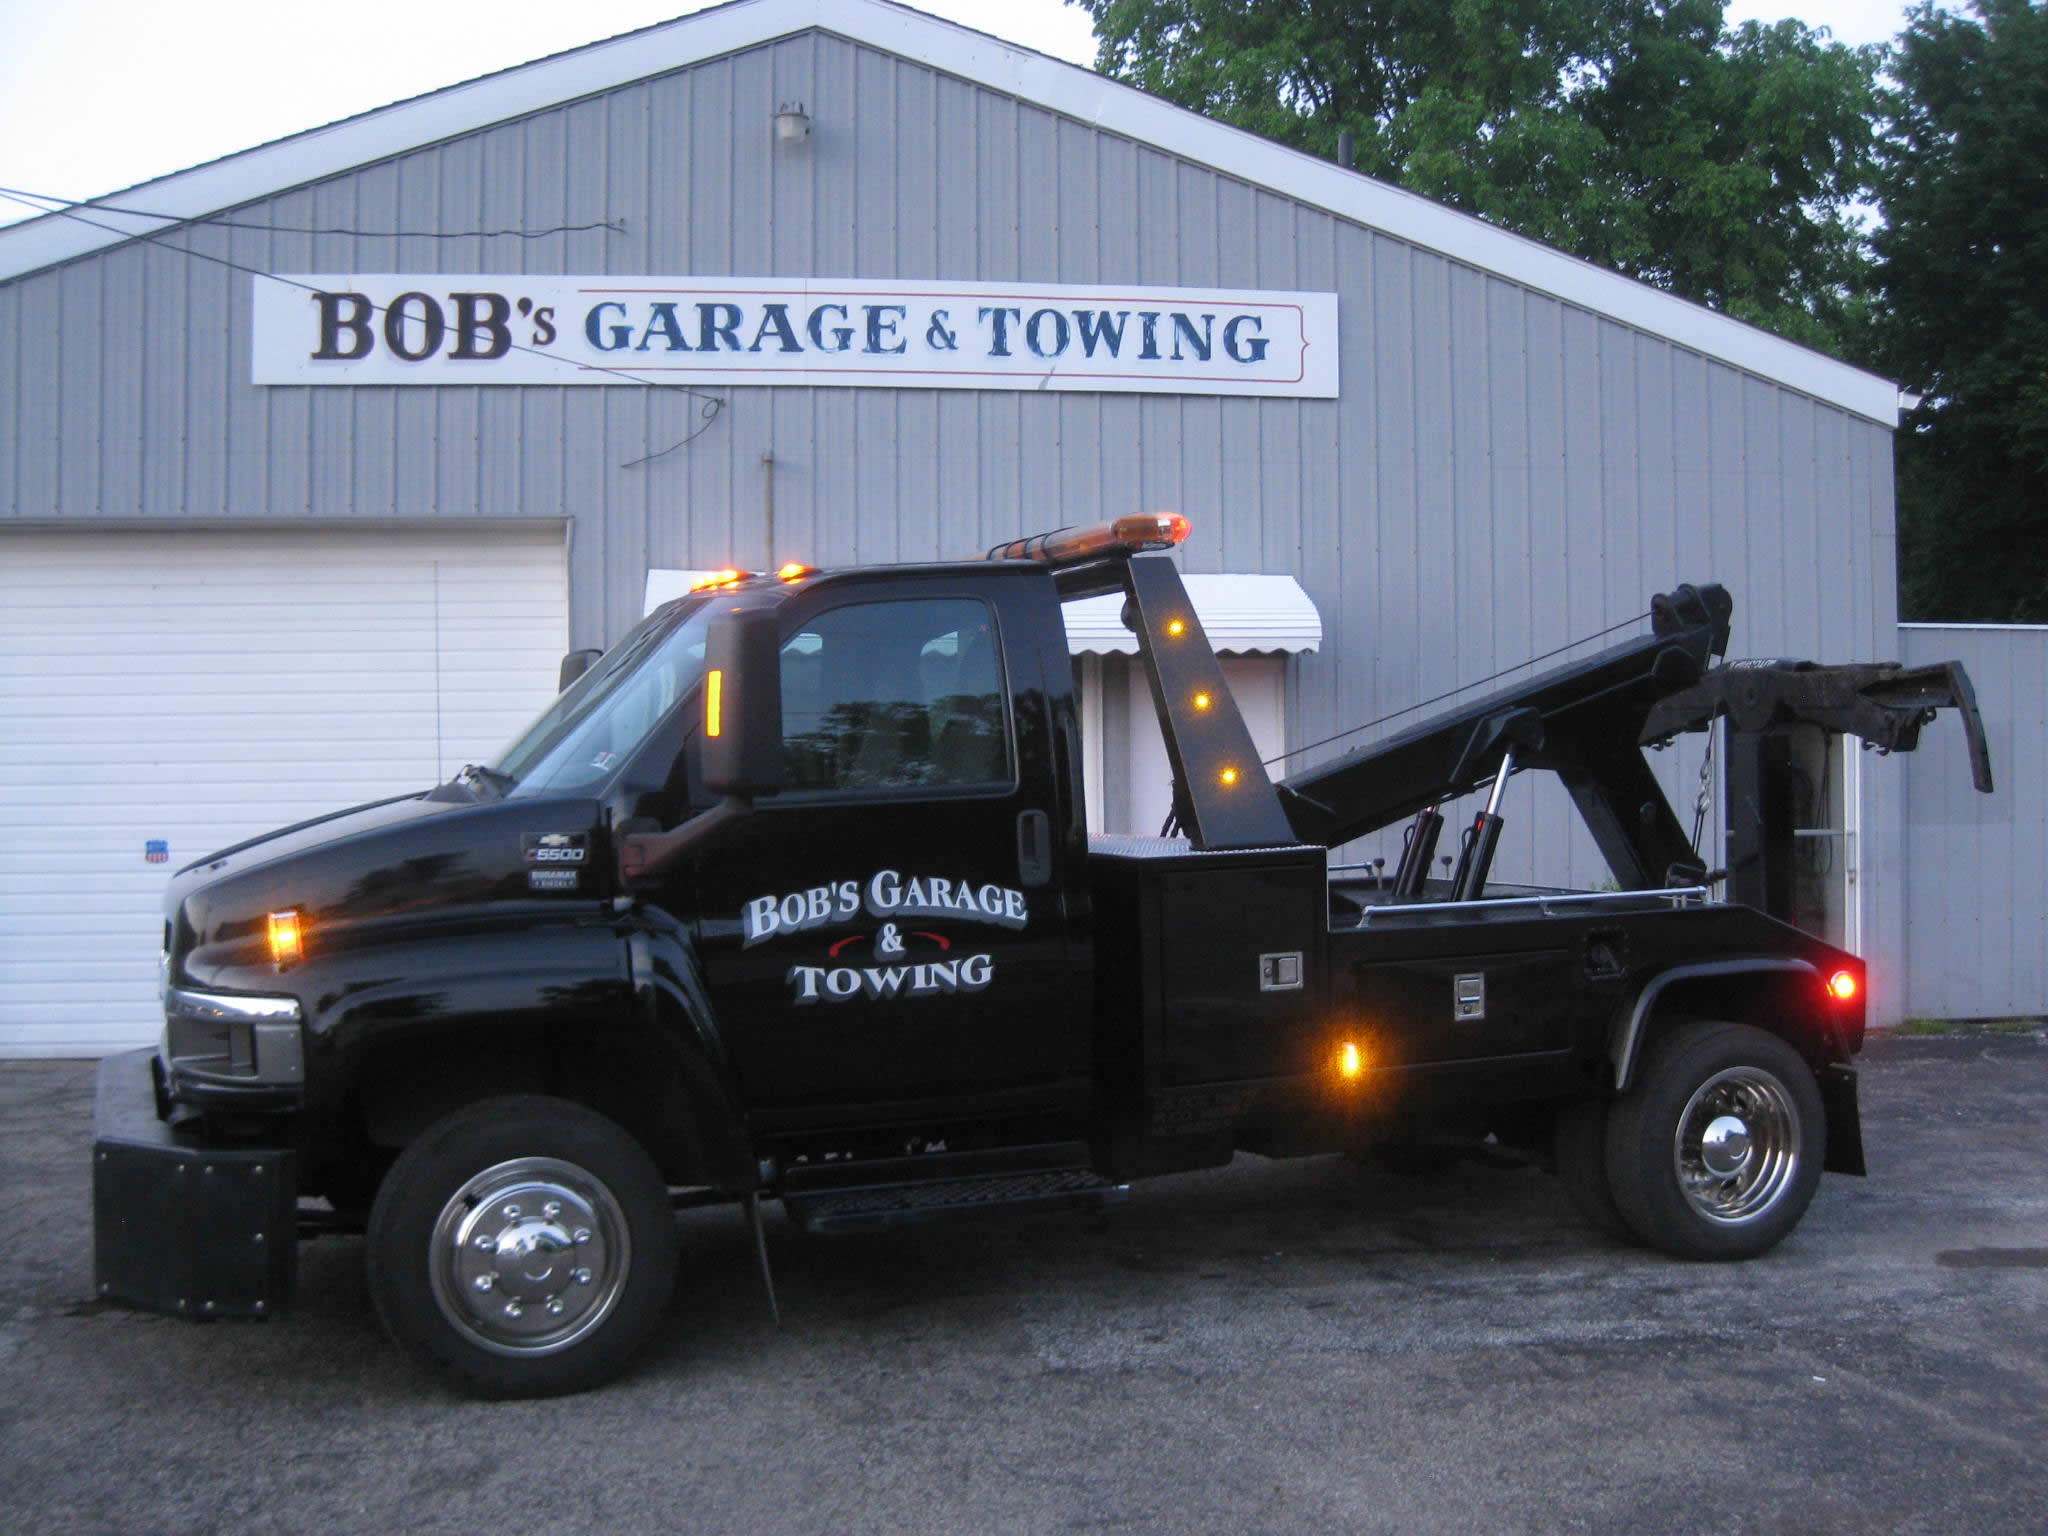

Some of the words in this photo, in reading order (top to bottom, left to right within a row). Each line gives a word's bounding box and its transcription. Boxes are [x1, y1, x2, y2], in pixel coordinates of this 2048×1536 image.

[585, 301, 908, 354] GARAGE
[925, 309, 960, 351] &
[978, 307, 1270, 363] TOWING
[878, 923, 905, 957] &
